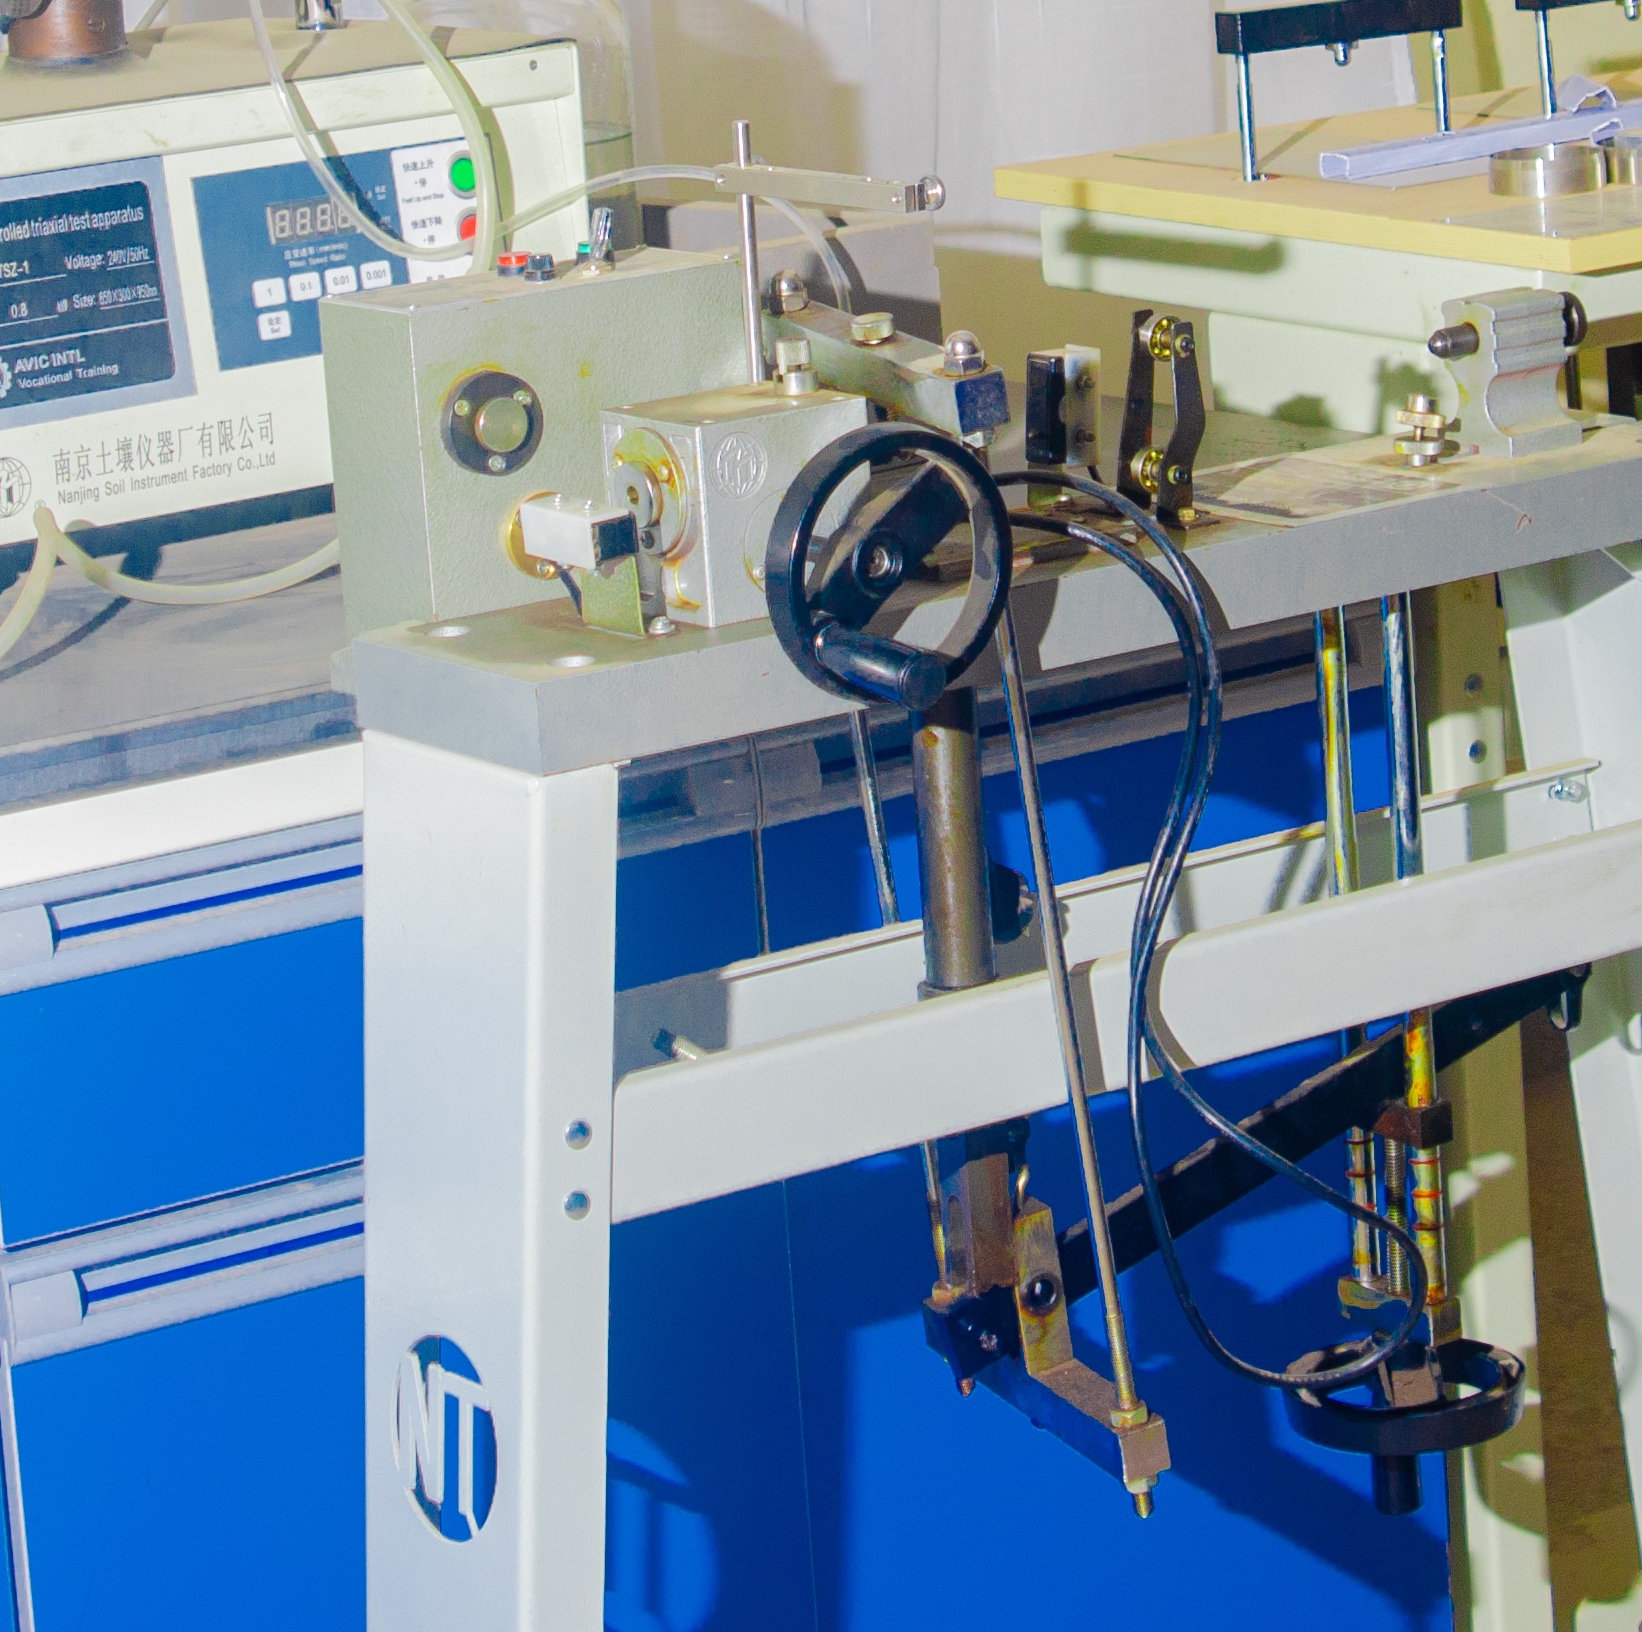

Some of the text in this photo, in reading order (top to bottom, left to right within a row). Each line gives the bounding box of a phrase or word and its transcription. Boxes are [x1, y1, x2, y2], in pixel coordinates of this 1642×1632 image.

[31, 213, 69, 236] triaxial
[69, 211, 91, 231] test
[92, 205, 144, 229] apparatus
[64, 253, 105, 270] Voltage:
[333, 275, 350, 285] 0.01
[366, 269, 387, 281] 0.001
[10, 302, 29, 318] 0.8
[14, 348, 86, 374] AVIC INTL
[18, 362, 119, 389] Vocational Training
[52, 411, 275, 486] 南京土壤仪器厂有限公司
[58, 485, 100, 505] Nanjing
[105, 479, 126, 496] Soil
[130, 470, 188, 492] Instrument
[193, 458, 233, 480] Factory
